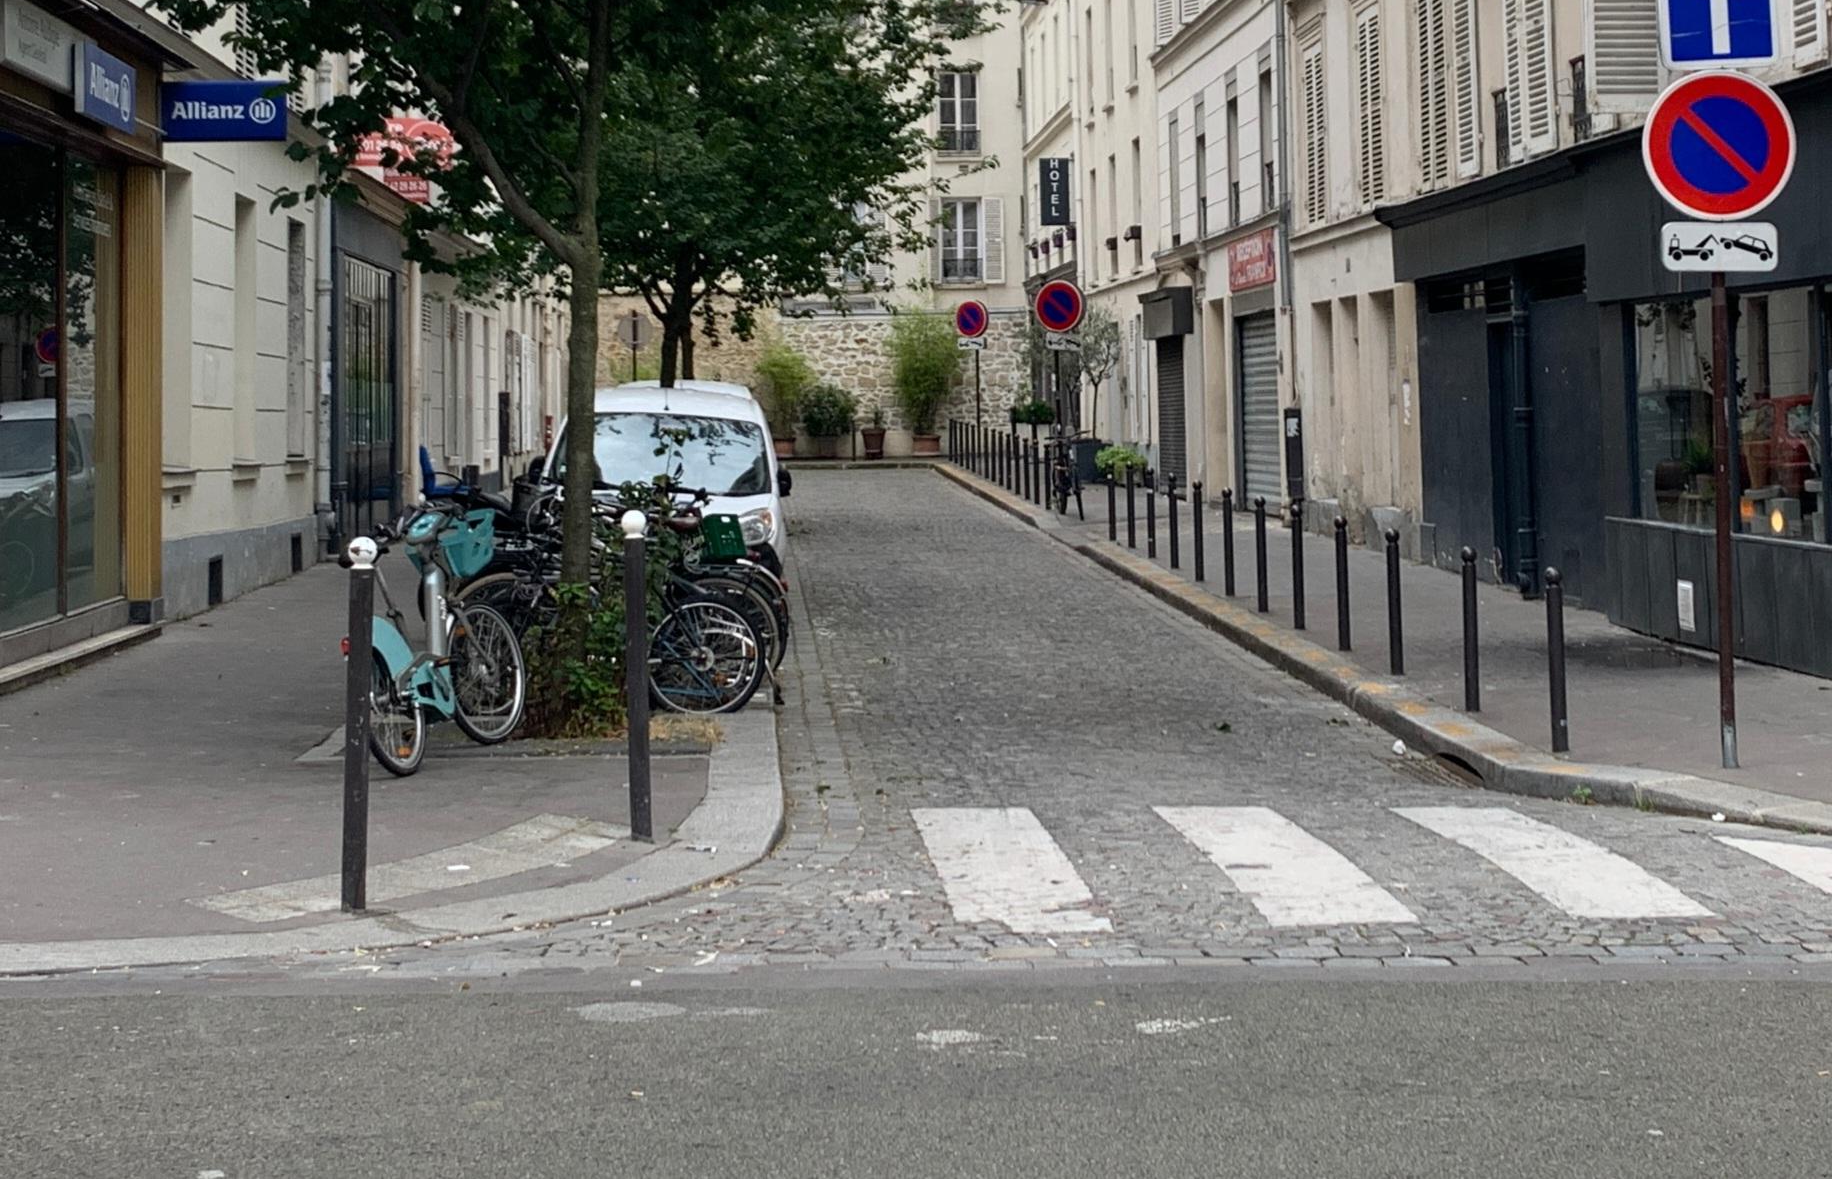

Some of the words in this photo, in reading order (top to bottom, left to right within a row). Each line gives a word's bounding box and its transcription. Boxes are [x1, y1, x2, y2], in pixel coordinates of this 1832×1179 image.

[90, 62, 120, 109] Allianz
[171, 101, 246, 120] Allianz
[1050, 158, 1060, 217] HOTEL
